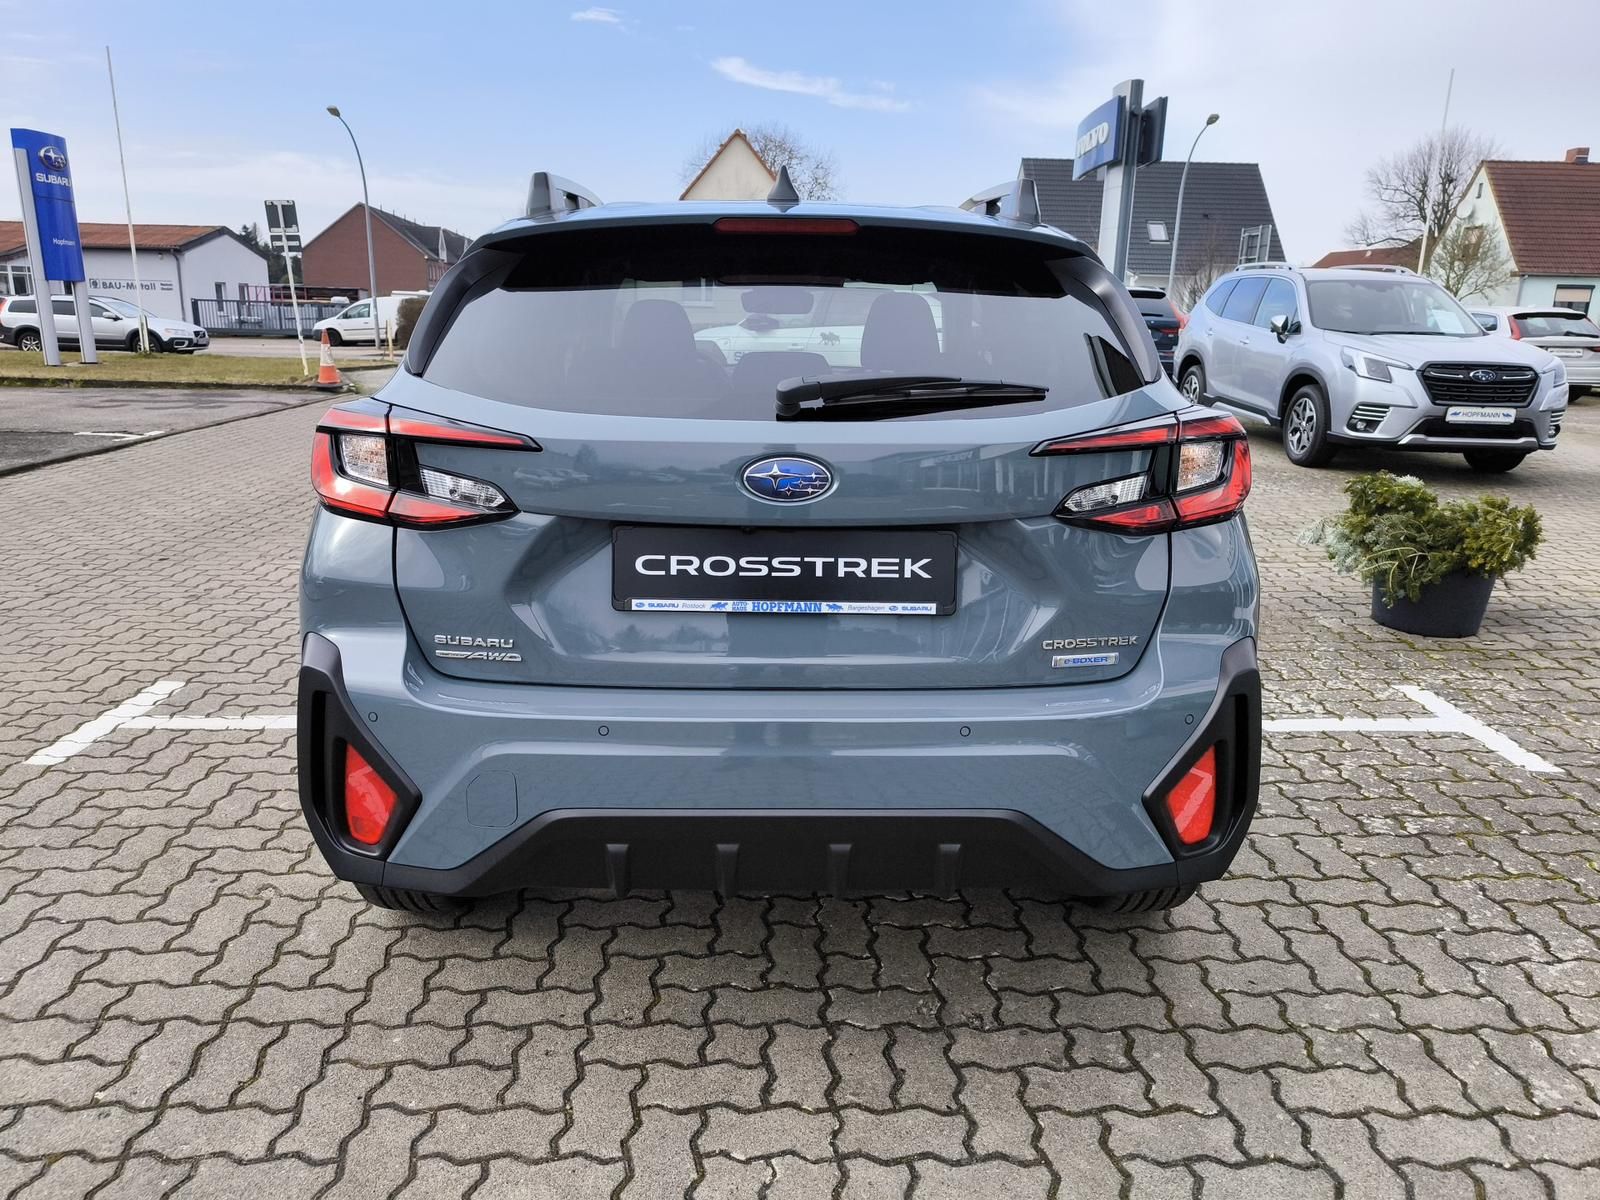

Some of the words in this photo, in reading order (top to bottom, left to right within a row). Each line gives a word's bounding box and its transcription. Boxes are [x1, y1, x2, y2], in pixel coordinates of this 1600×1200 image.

[634, 554, 933, 579] CROSSTREK
[752, 601, 823, 612] HOPFMANN
[434, 634, 514, 648] SUBARU
[1042, 635, 1139, 650] CROSSTREK
[466, 651, 522, 662] AWD
[1064, 656, 1108, 665] e-BOXER
